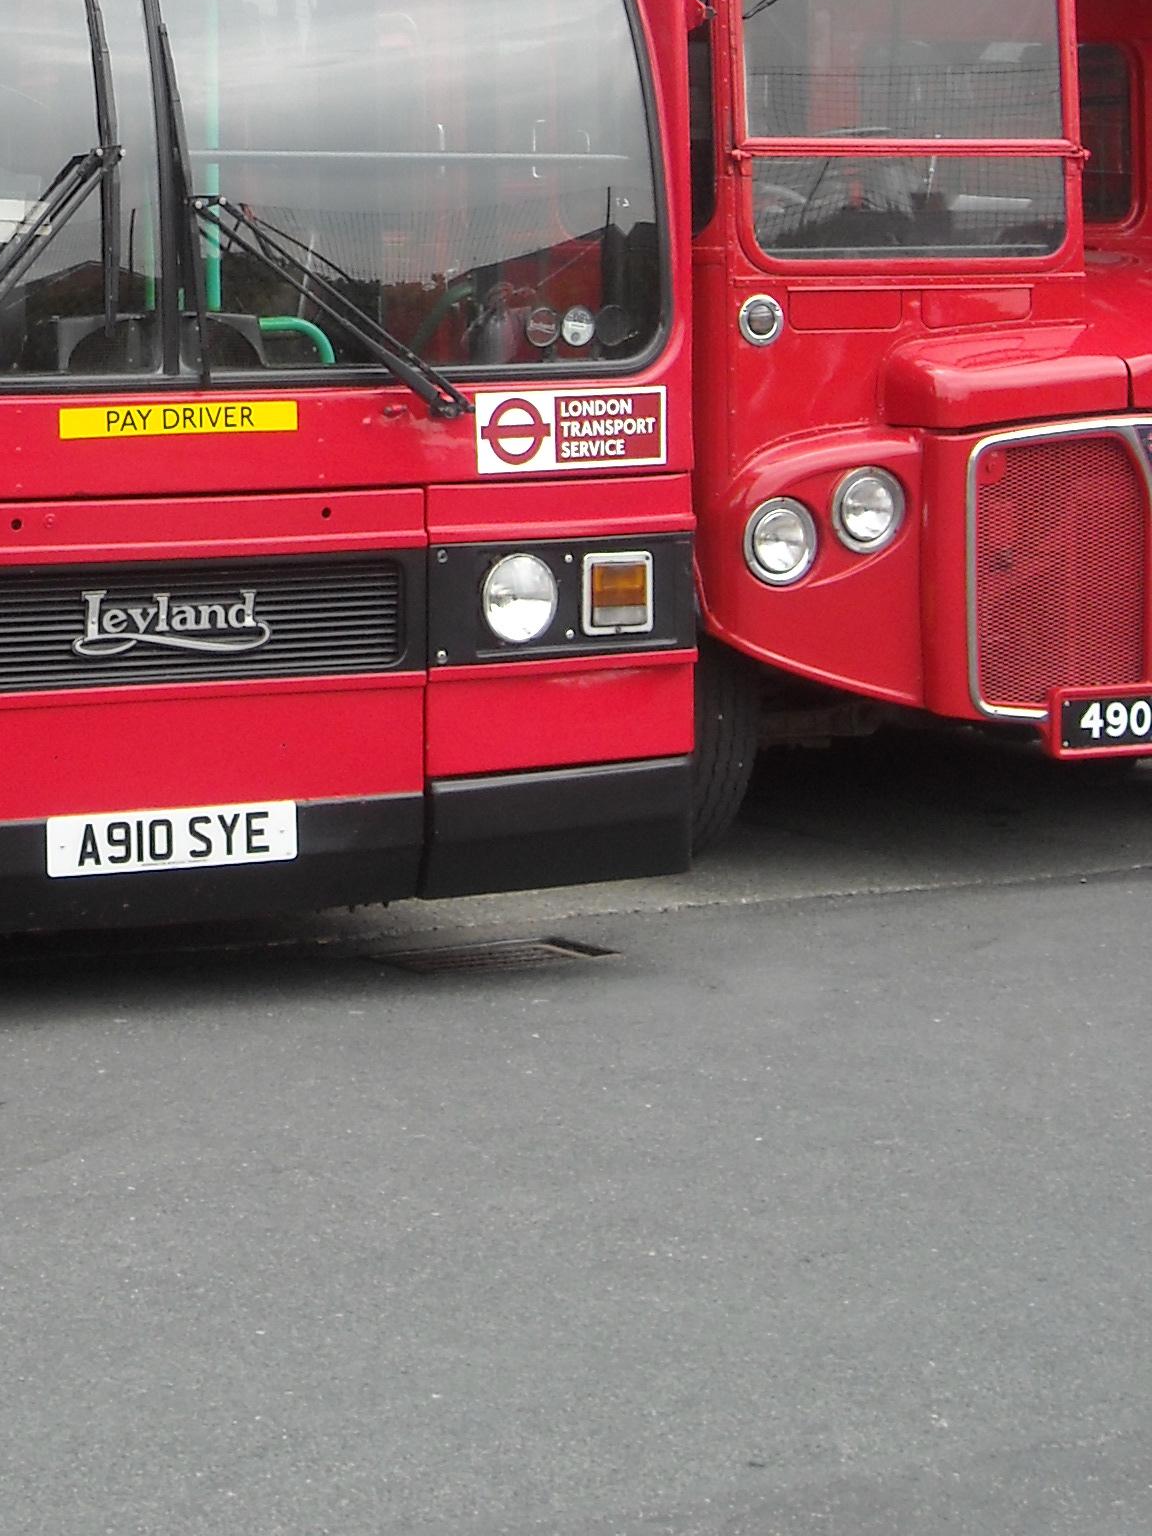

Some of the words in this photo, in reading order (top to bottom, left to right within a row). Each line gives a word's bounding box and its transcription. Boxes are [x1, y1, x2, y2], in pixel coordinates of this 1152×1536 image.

[106, 409, 152, 432] PAY
[163, 406, 255, 430] DRIVER
[560, 398, 632, 417] LONDON
[560, 417, 656, 438] TRANSPORT
[561, 439, 625, 458] SERVICE
[74, 589, 270, 655] Leyland
[1080, 700, 1152, 738] 490
[78, 818, 173, 866] A910
[188, 811, 270, 858] SYE
